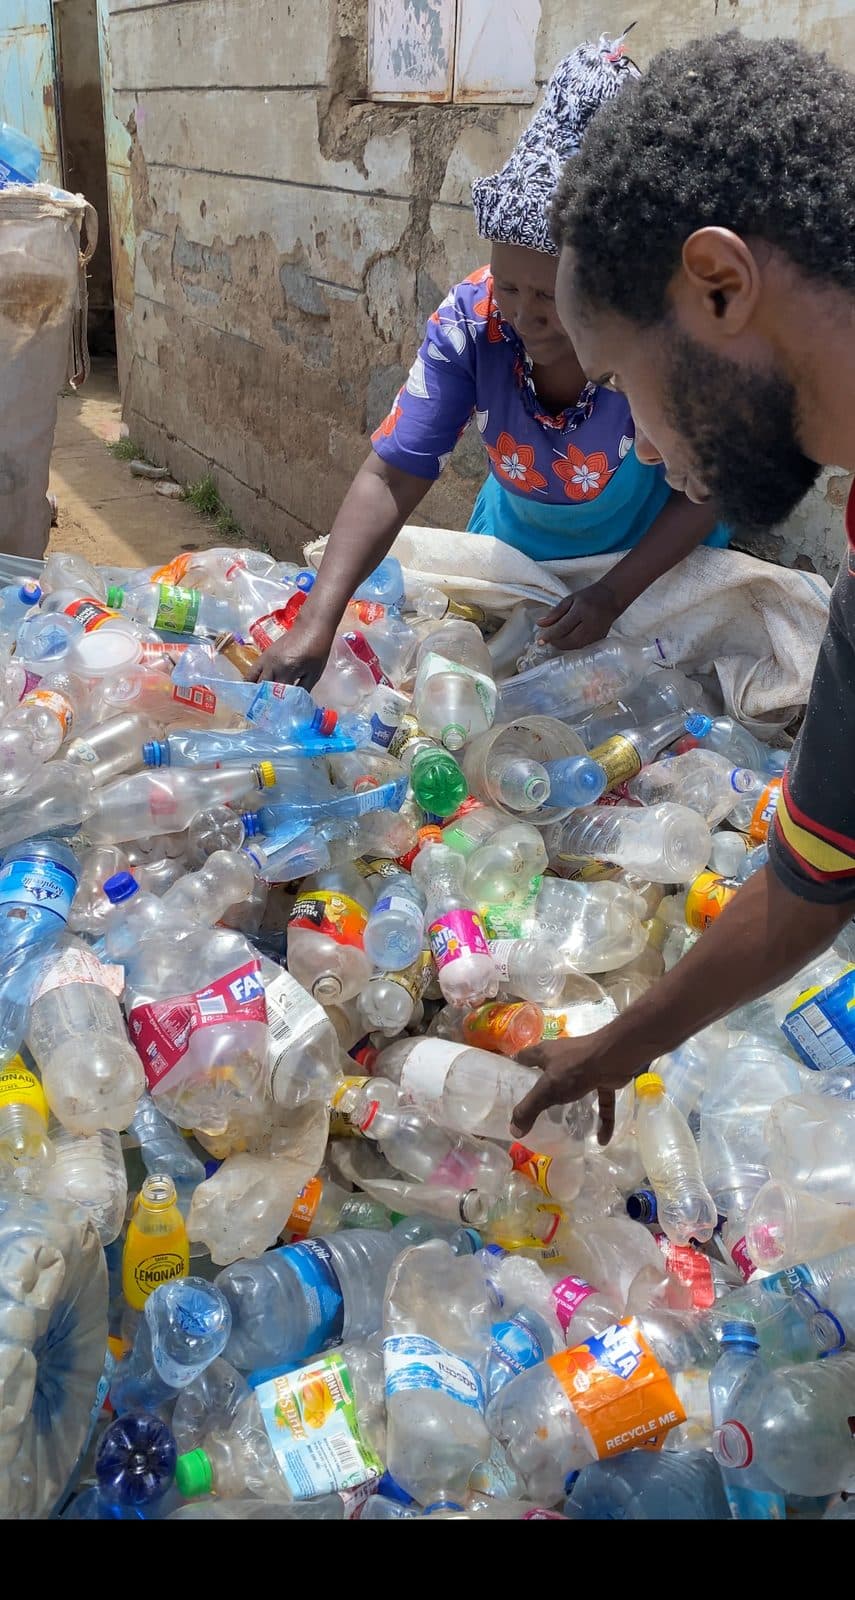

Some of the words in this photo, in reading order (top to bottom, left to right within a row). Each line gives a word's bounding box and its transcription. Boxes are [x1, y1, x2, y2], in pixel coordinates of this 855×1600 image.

[134, 1262, 185, 1282] LEMONADE
[438, 1362, 477, 1391] dasani
[606, 1420, 657, 1450] RECYCLE
[659, 1411, 678, 1426] ME
